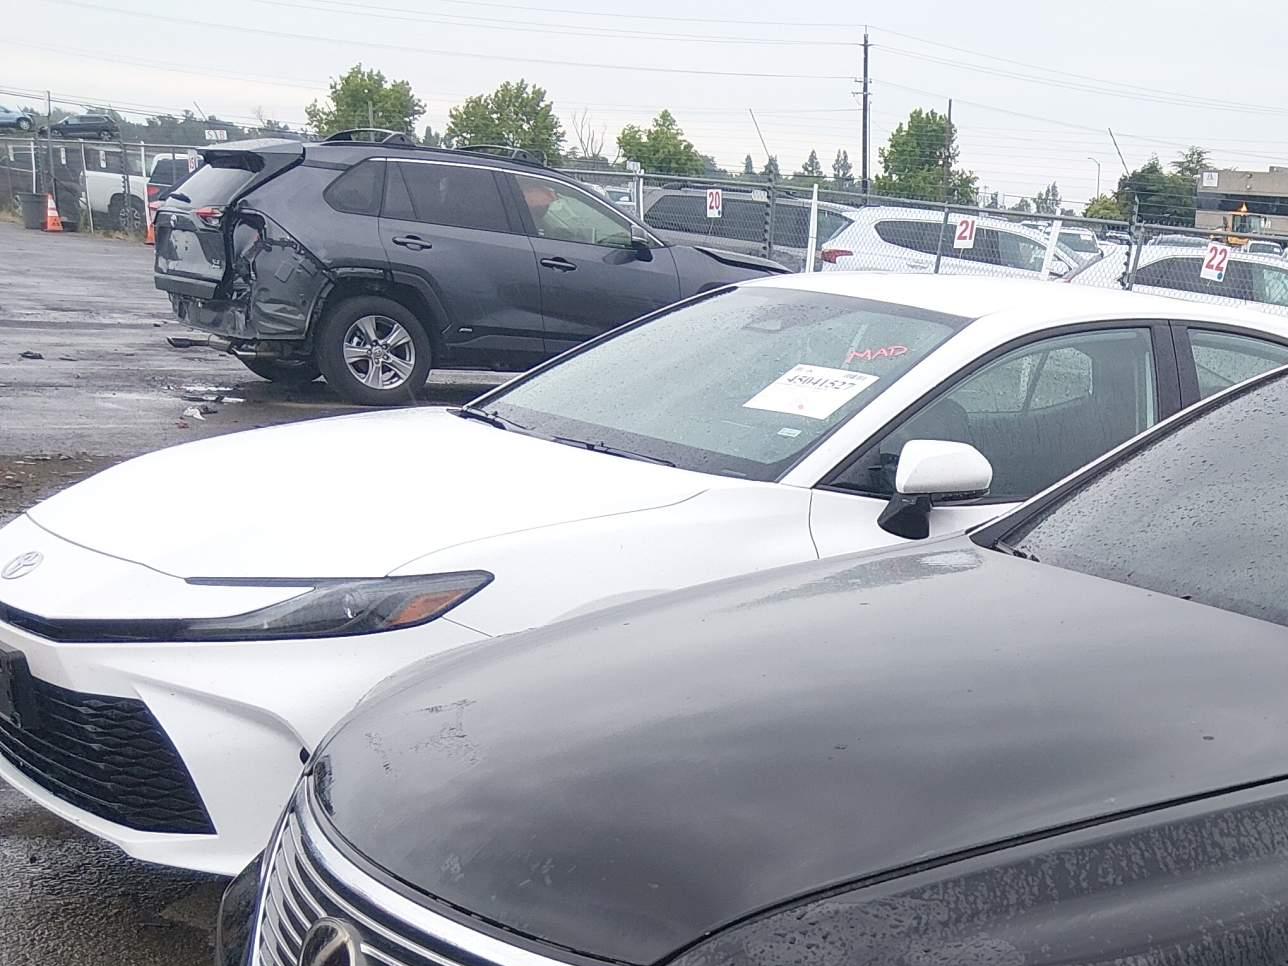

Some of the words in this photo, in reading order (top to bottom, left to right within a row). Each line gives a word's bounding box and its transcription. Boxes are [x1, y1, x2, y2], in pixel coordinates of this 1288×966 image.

[709, 192, 720, 210] 20
[957, 220, 975, 240] 21
[1205, 246, 1228, 271] 22
[848, 345, 908, 364] MAD
